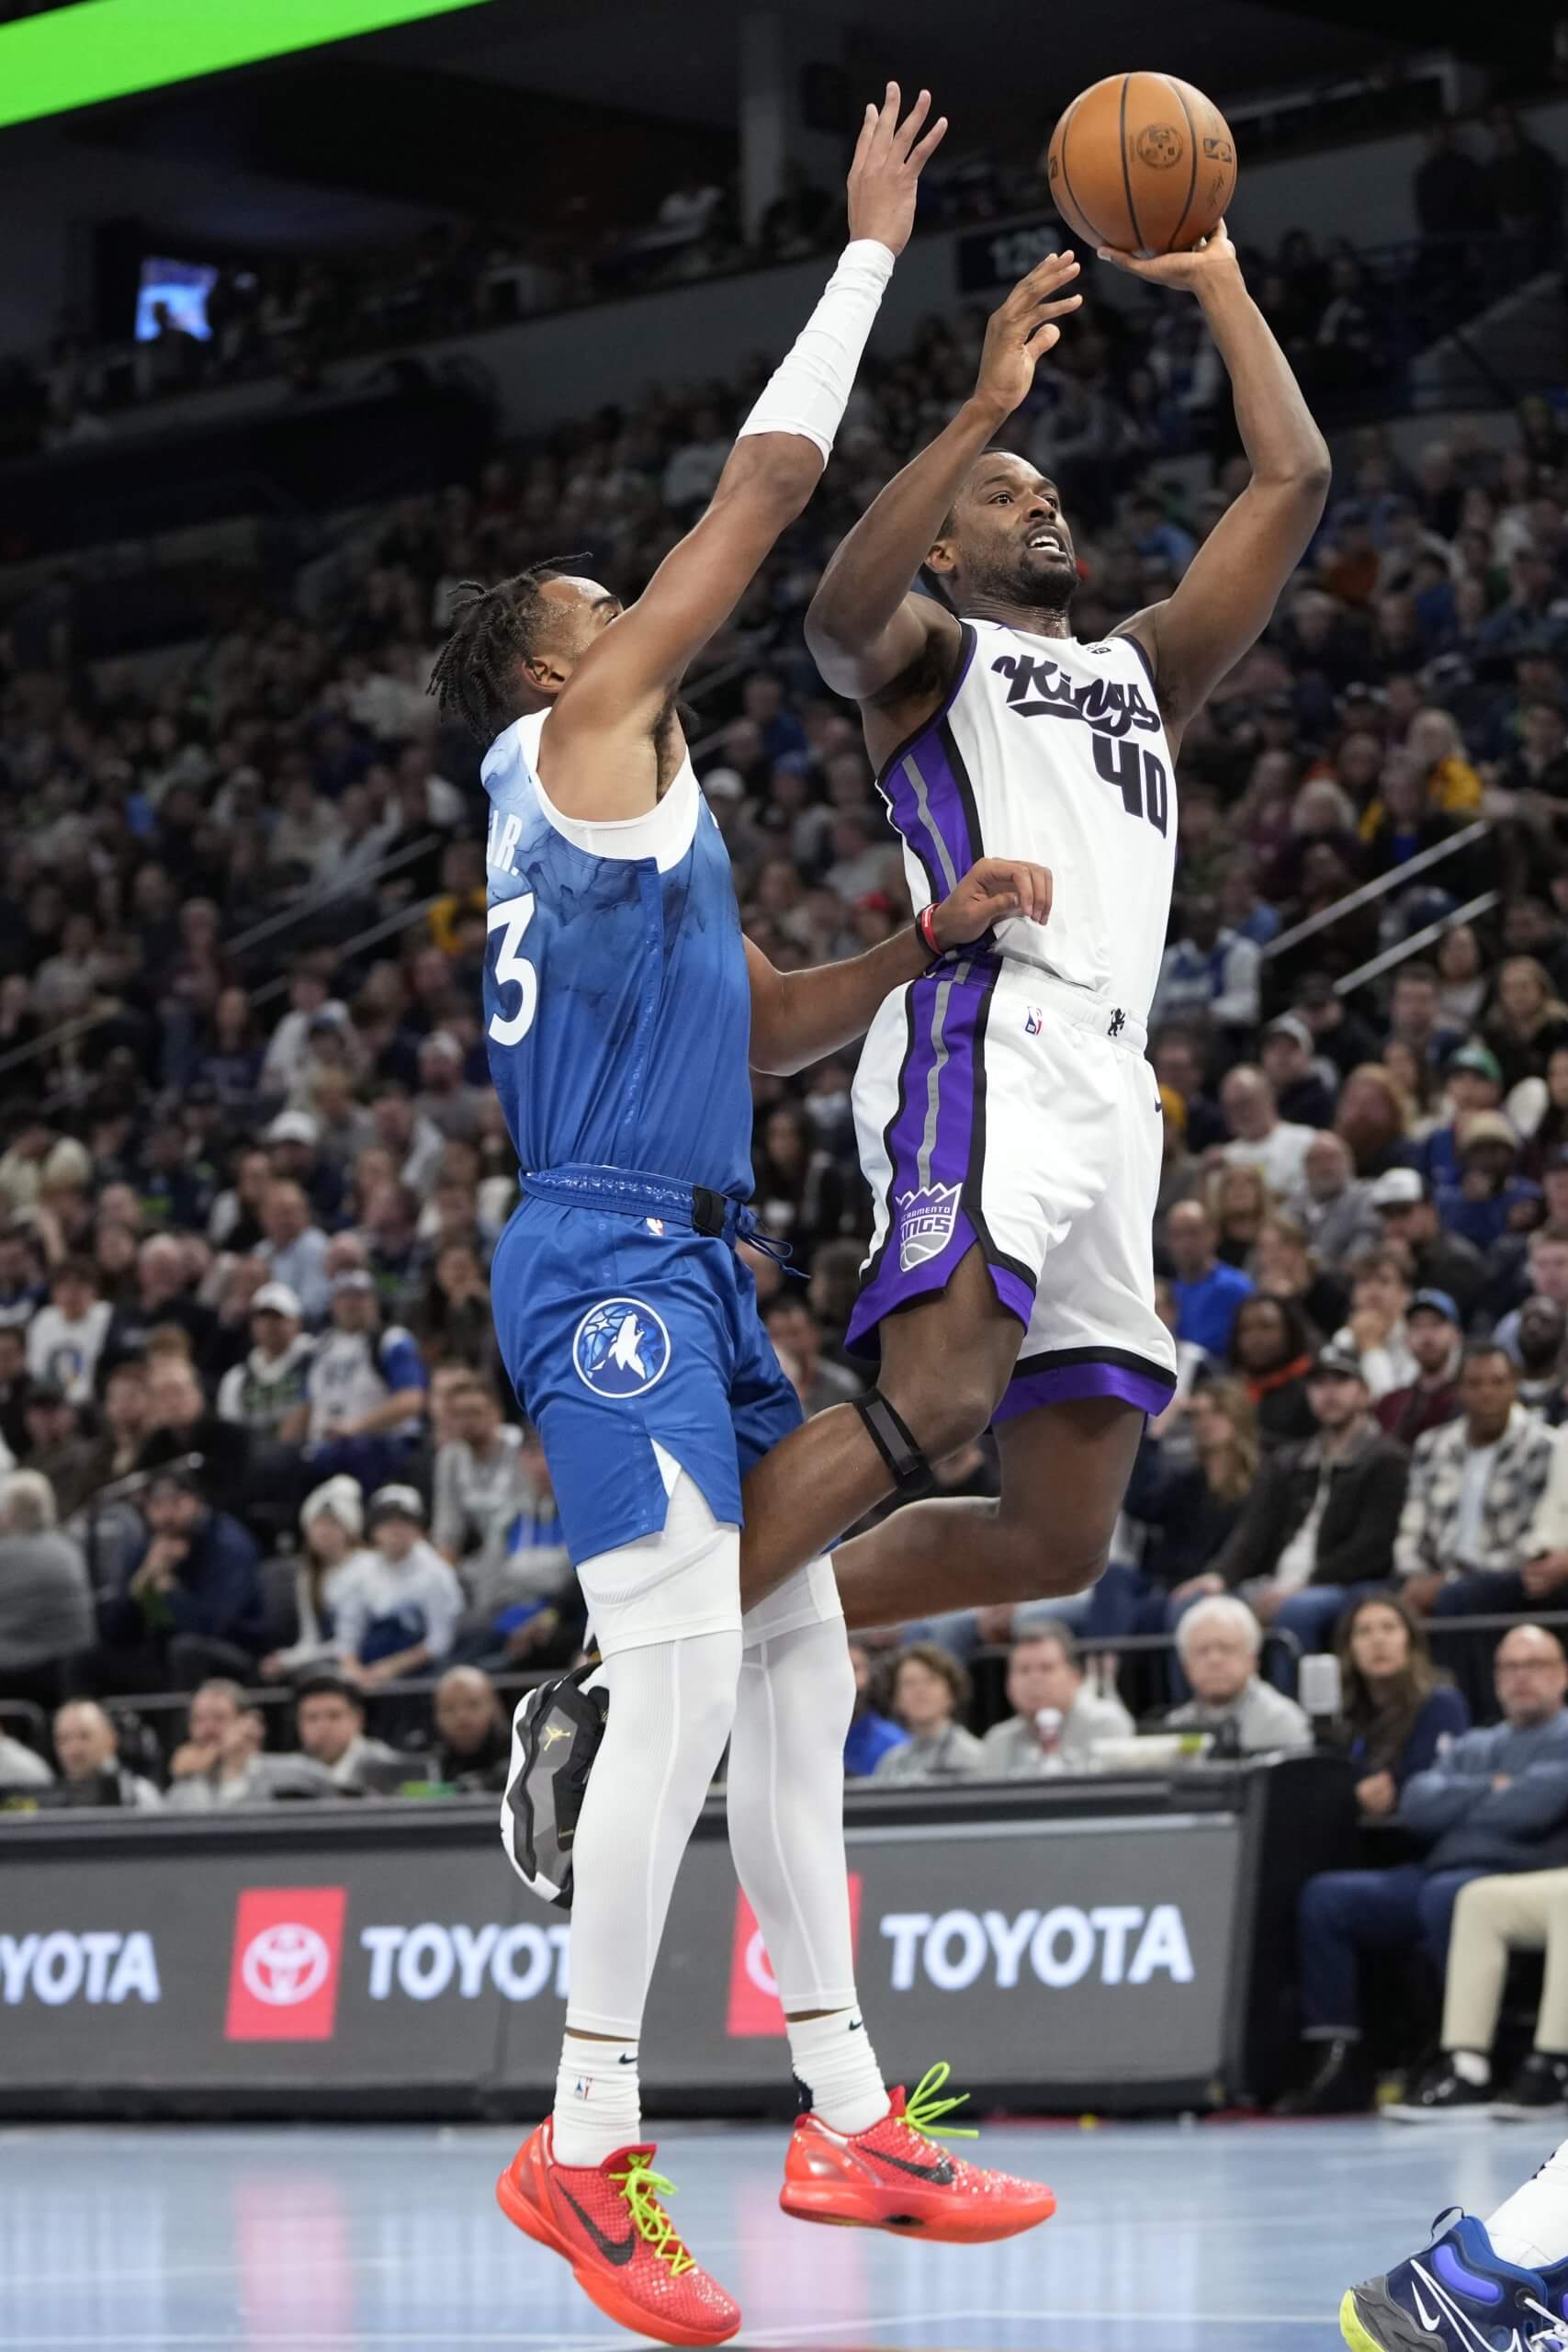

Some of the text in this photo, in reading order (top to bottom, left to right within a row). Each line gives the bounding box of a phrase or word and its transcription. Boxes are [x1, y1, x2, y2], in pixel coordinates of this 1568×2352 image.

[990, 654, 1161, 738] Kings
[1092, 731, 1168, 840] 40
[360, 1920, 571, 2003] TOYOT
[879, 1904, 1195, 1991] TOYOTA
